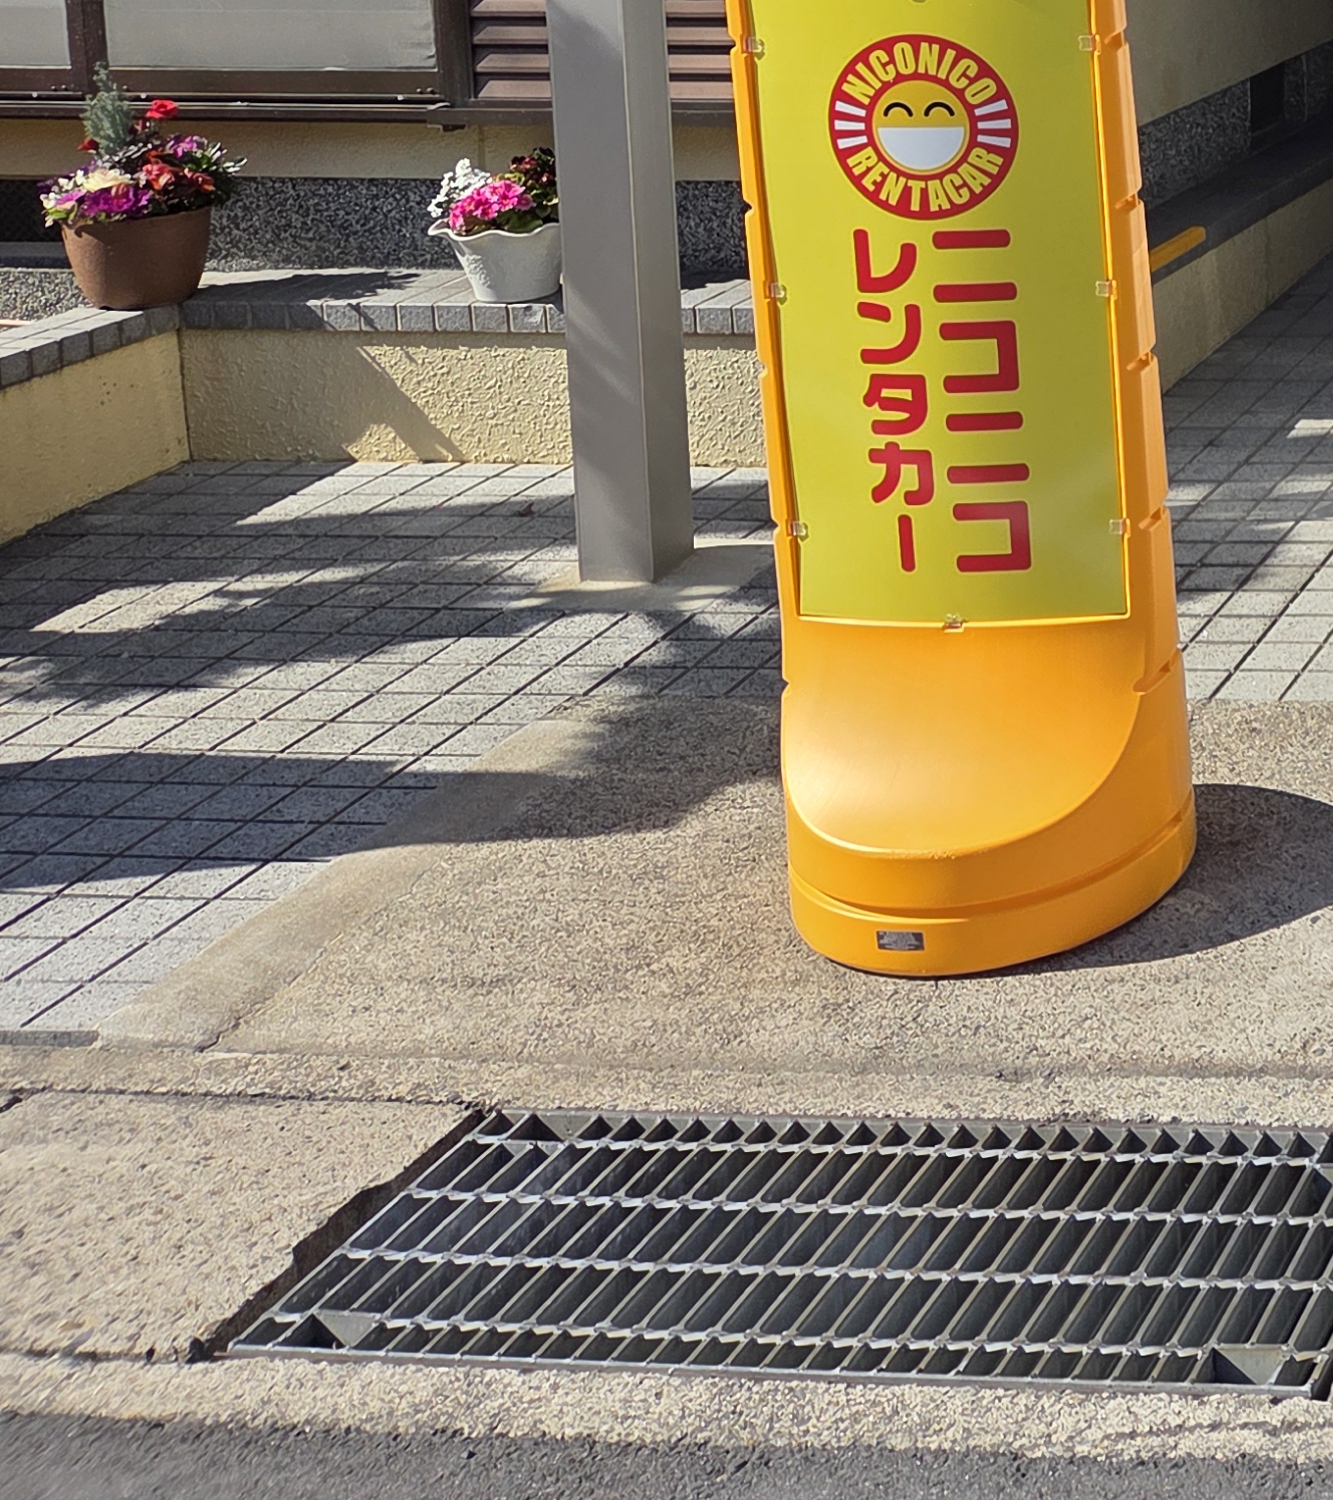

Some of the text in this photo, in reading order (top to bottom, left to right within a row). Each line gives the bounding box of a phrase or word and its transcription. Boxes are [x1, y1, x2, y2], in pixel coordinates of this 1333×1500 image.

[841, 41, 999, 106] NICONICO
[845, 144, 1004, 213] RENTACAR
[852, 228, 935, 573] レンタカー
[931, 229, 1033, 573] ニコニコ
